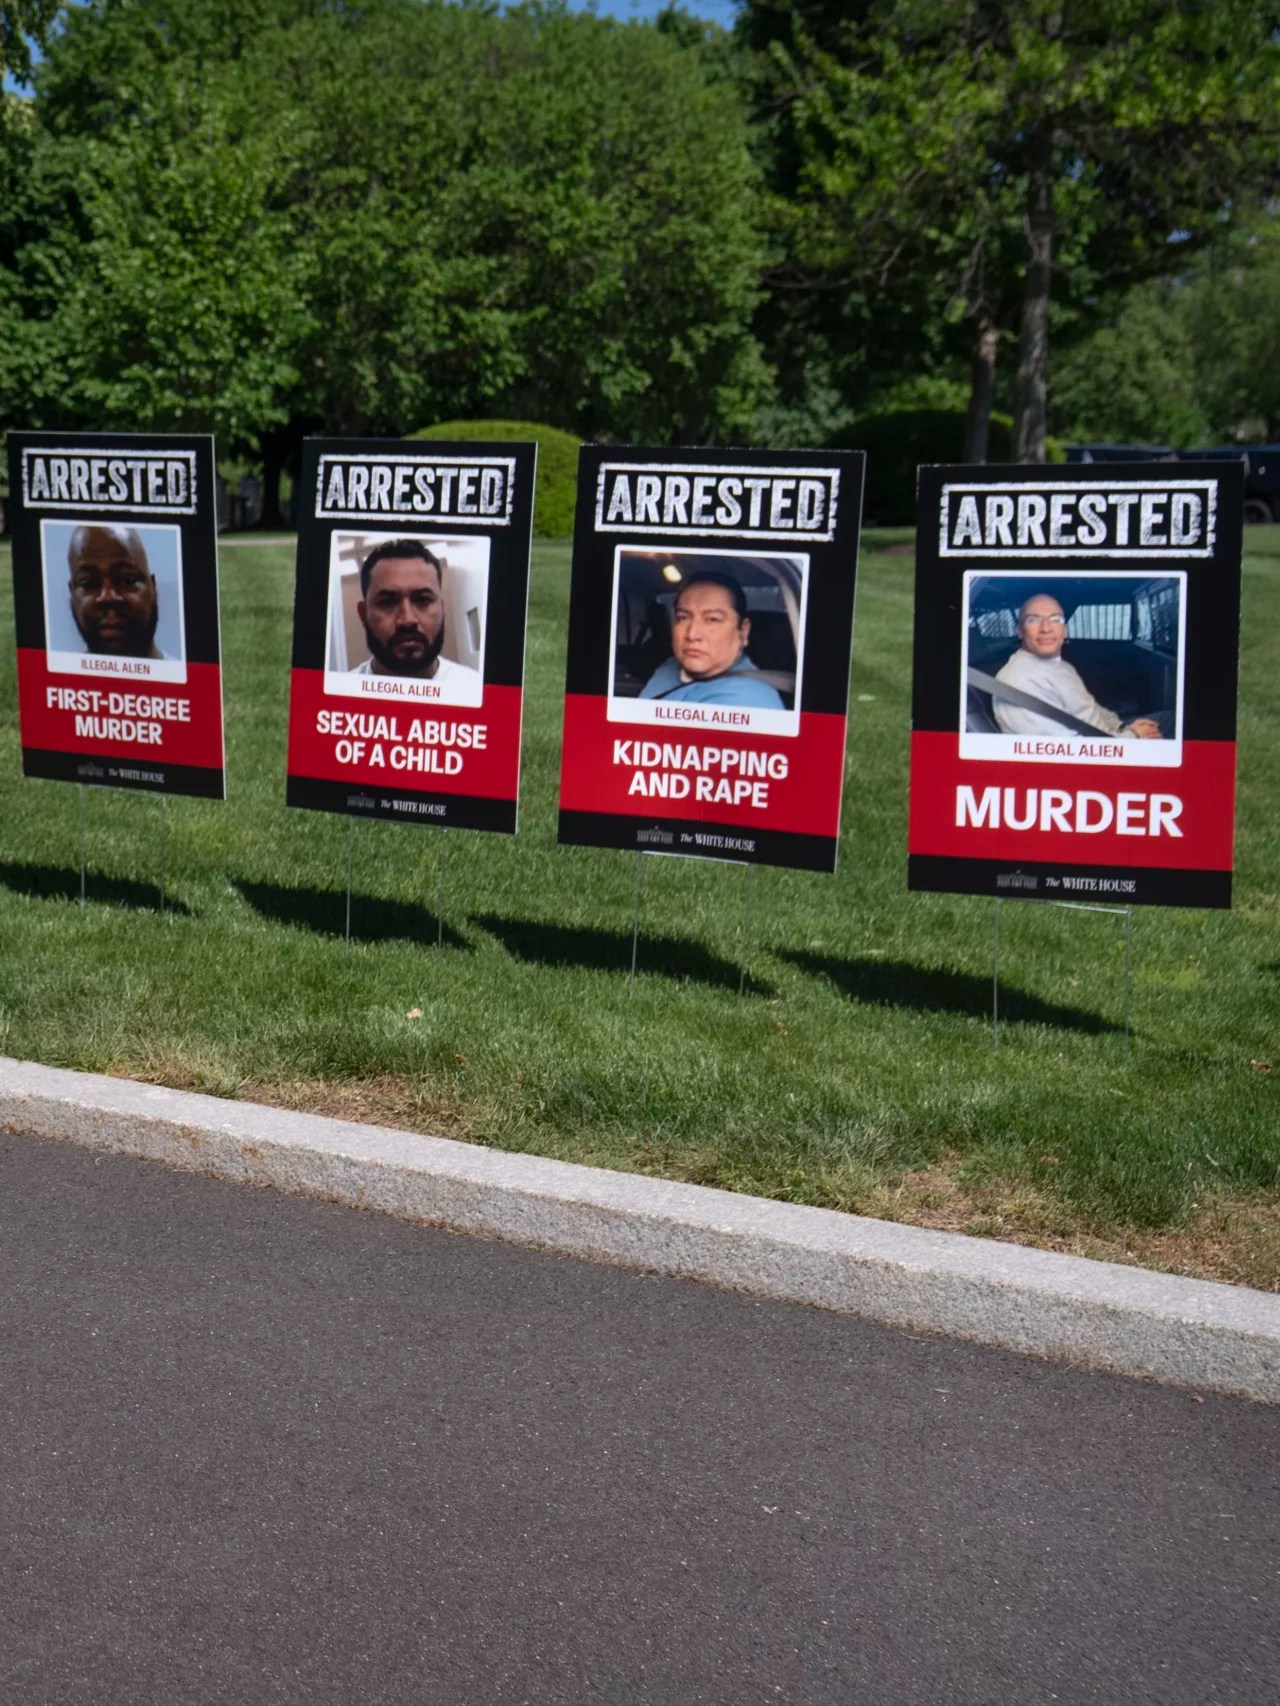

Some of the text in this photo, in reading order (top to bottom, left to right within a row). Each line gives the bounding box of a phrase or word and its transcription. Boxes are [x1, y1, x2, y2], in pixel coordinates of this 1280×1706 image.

[31, 457, 187, 504] ARRESTED
[325, 465, 503, 515] ARRESTED
[606, 474, 825, 529] ARRESTED
[952, 493, 1203, 546] ARRESTED
[81, 659, 150, 674] ILLEGAL ALIEN
[46, 686, 191, 722] FIRST-DEGREE
[361, 680, 441, 697] ILLEGAL ALIEN
[75, 714, 163, 745] MURDER
[316, 709, 487, 749] SEXUAL ABUSE
[655, 706, 751, 725] ILLEGAL ALIEN
[335, 740, 463, 775] OF A CHILD
[612, 739, 789, 780] KIDNAPPING
[1013, 742, 1124, 757] ILLEGAL ALIEN
[628, 770, 769, 808] AND RAPE
[380, 800, 446, 816] The WHITE HOUSE
[955, 784, 1184, 837] MURDER
[680, 833, 755, 852] The WHITE HOUSE
[1045, 876, 1136, 892] The WHITE HOUSE
